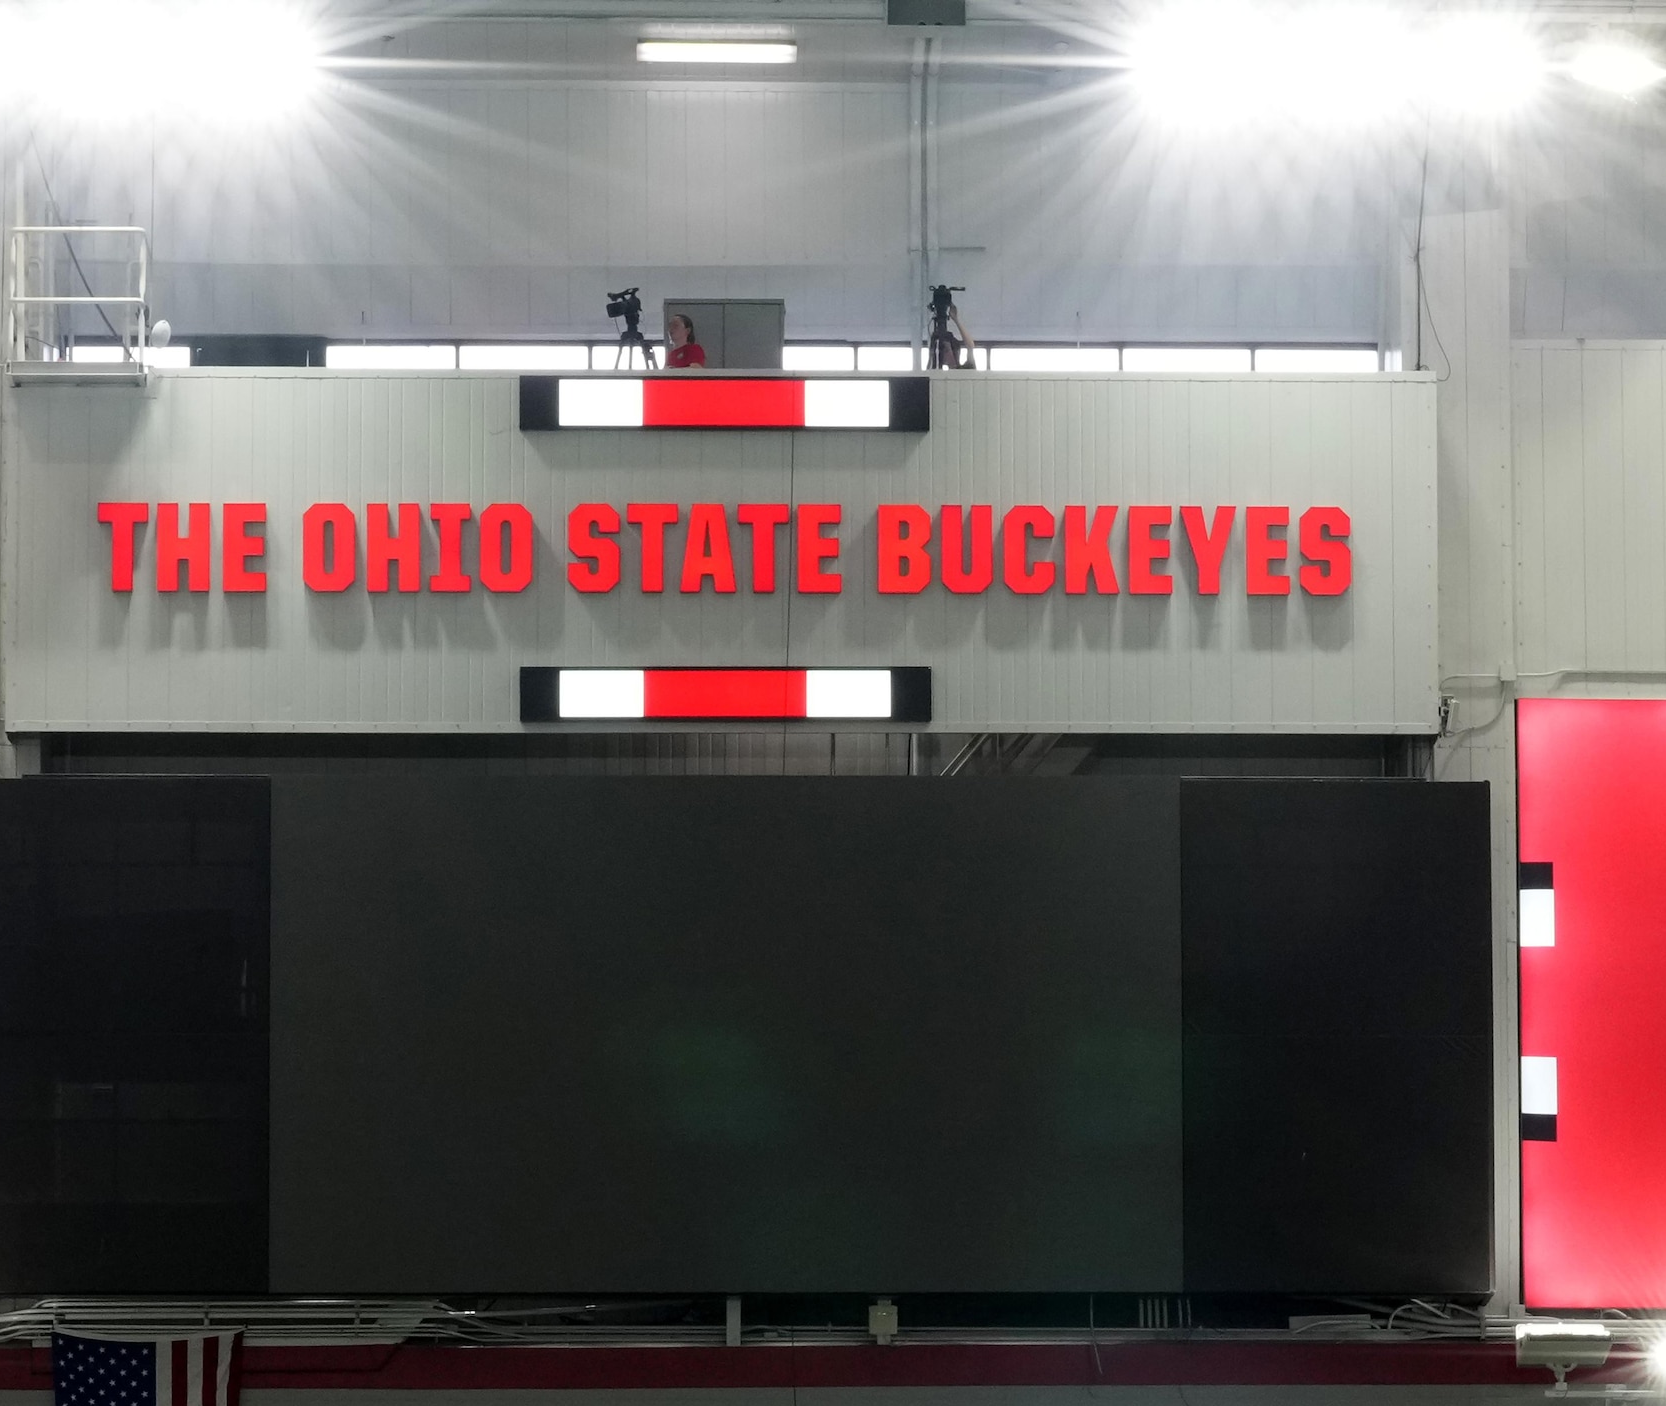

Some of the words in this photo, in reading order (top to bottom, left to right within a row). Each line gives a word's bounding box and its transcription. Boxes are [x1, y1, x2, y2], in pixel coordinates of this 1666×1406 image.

[98, 502, 268, 593] THE
[302, 502, 533, 593] OHIO
[567, 503, 843, 594] STATE
[877, 503, 1352, 596] BUCKEYES
